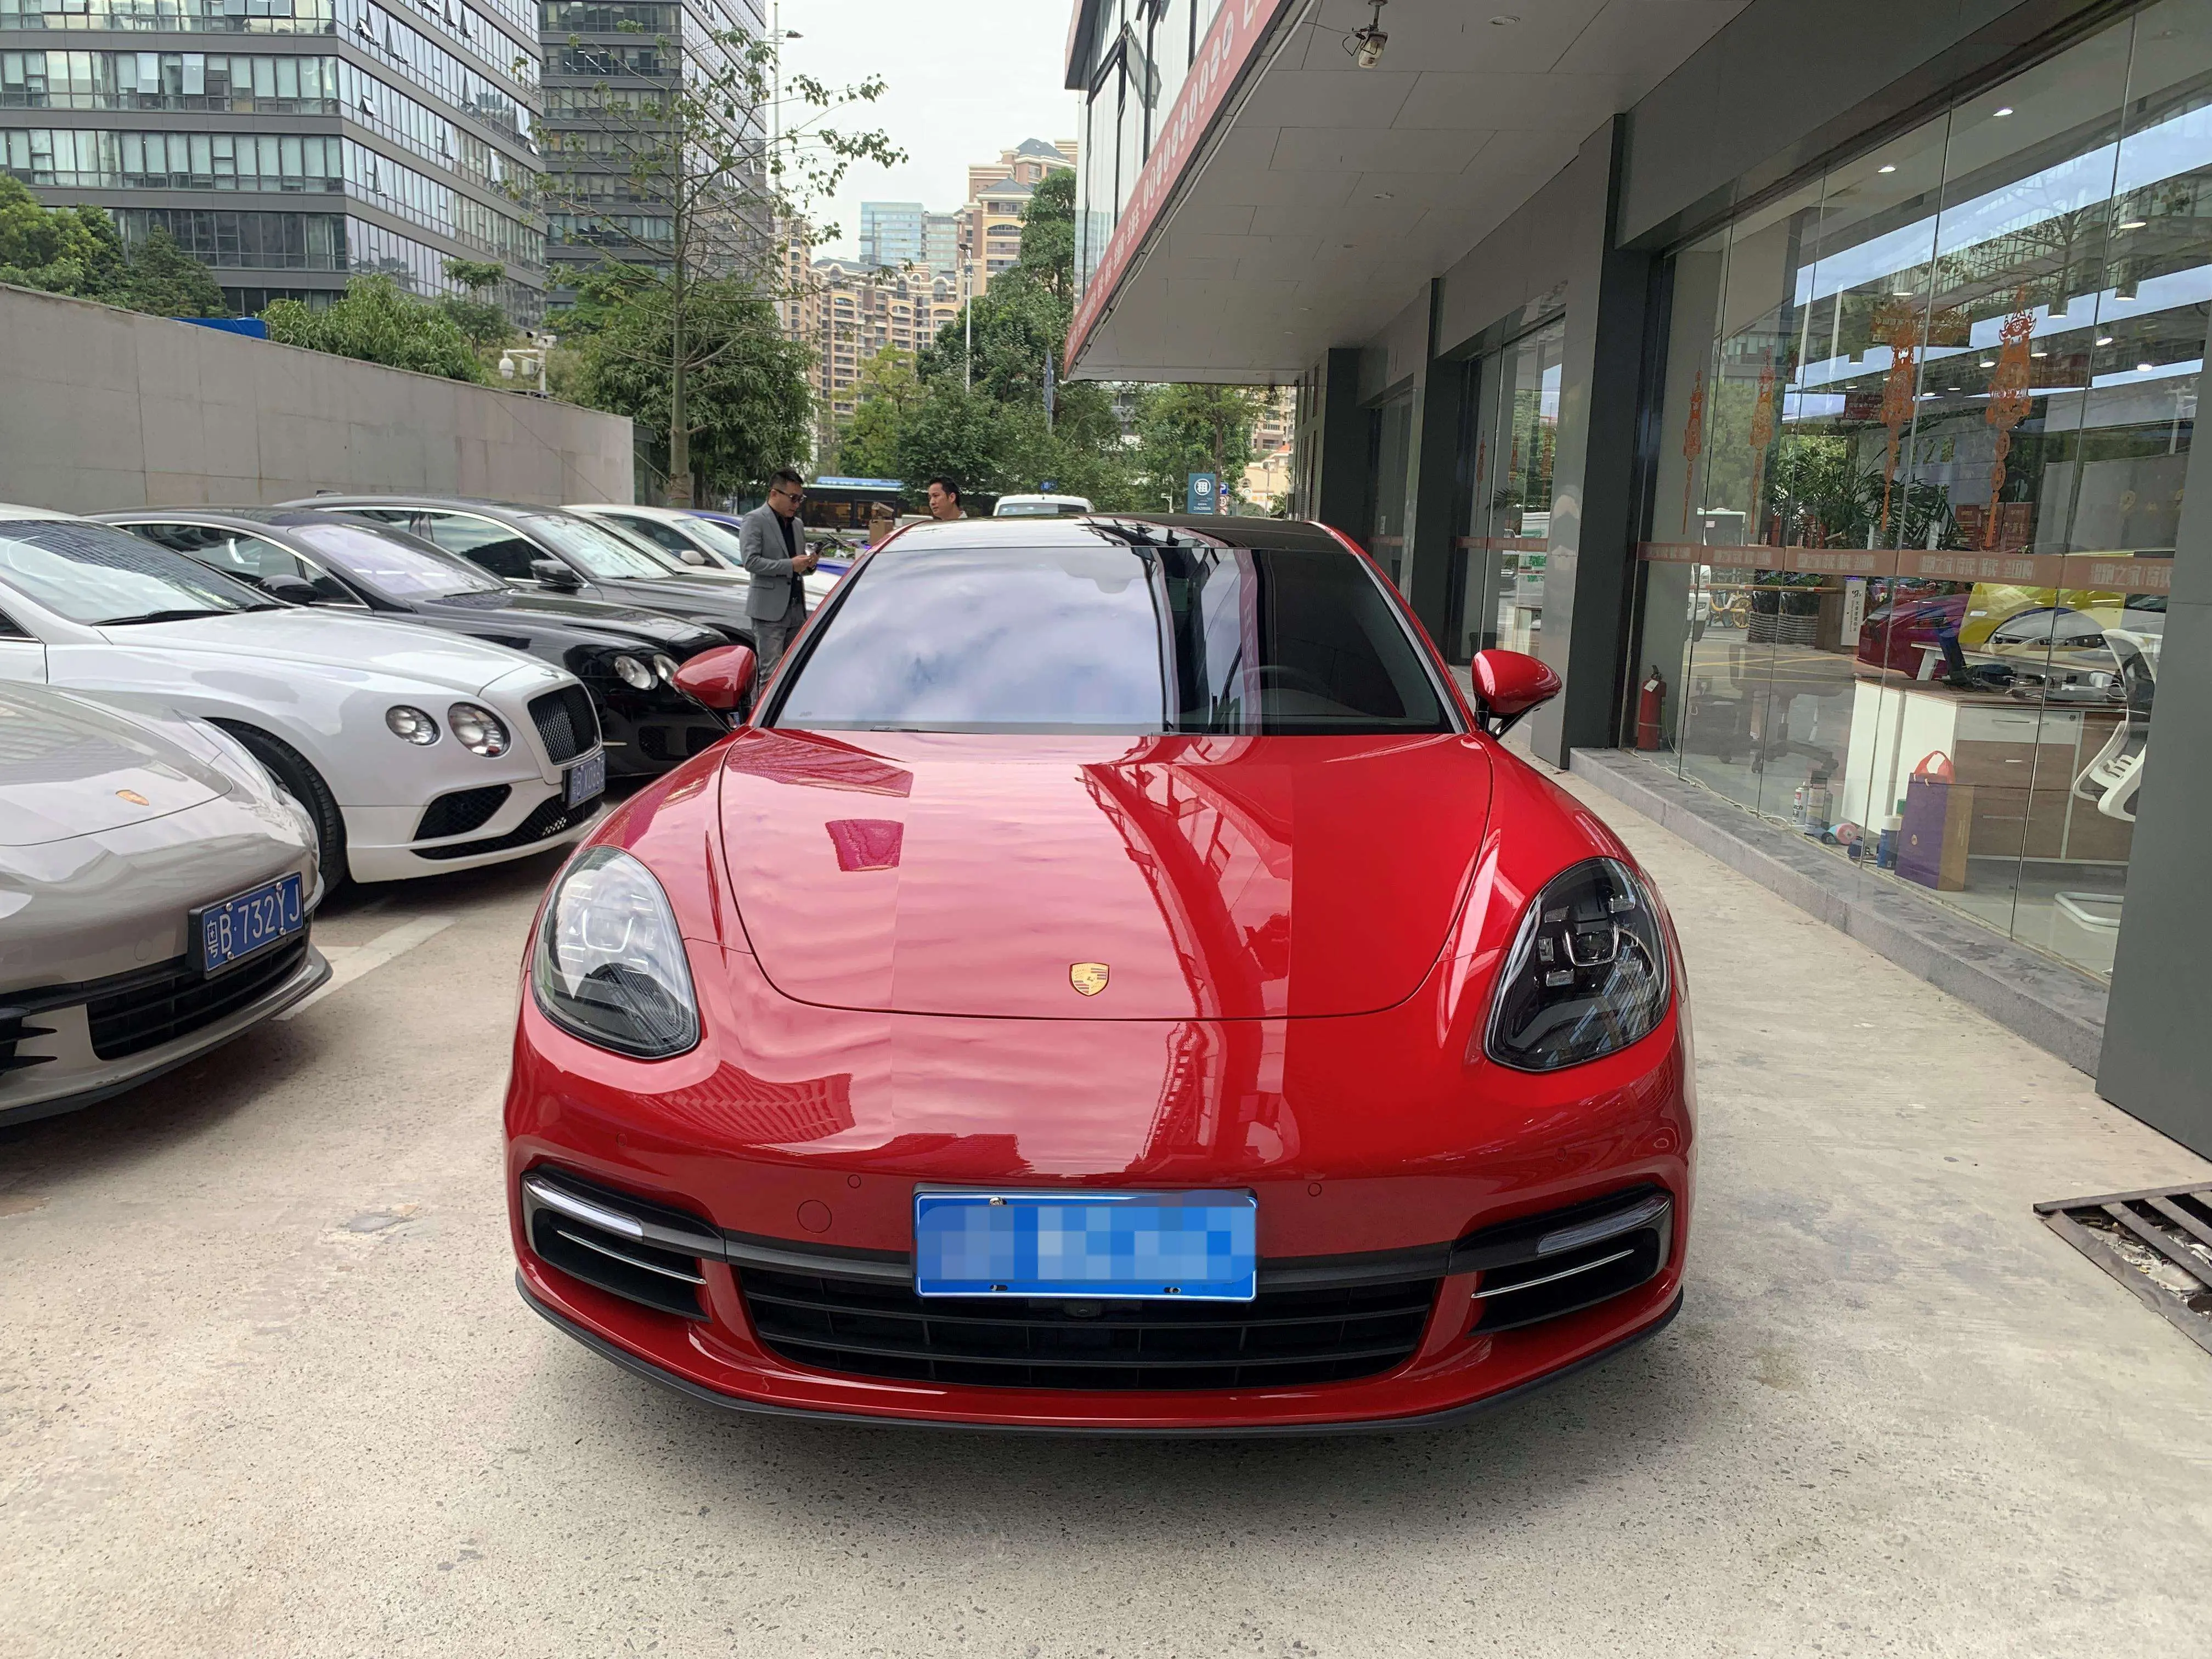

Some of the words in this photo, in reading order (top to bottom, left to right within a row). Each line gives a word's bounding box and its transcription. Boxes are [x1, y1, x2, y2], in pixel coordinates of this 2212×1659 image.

[1197, 482, 1208, 493] 租
[1220, 484, 1226, 494] P
[206, 883, 300, 958] 粤B·732YJ
